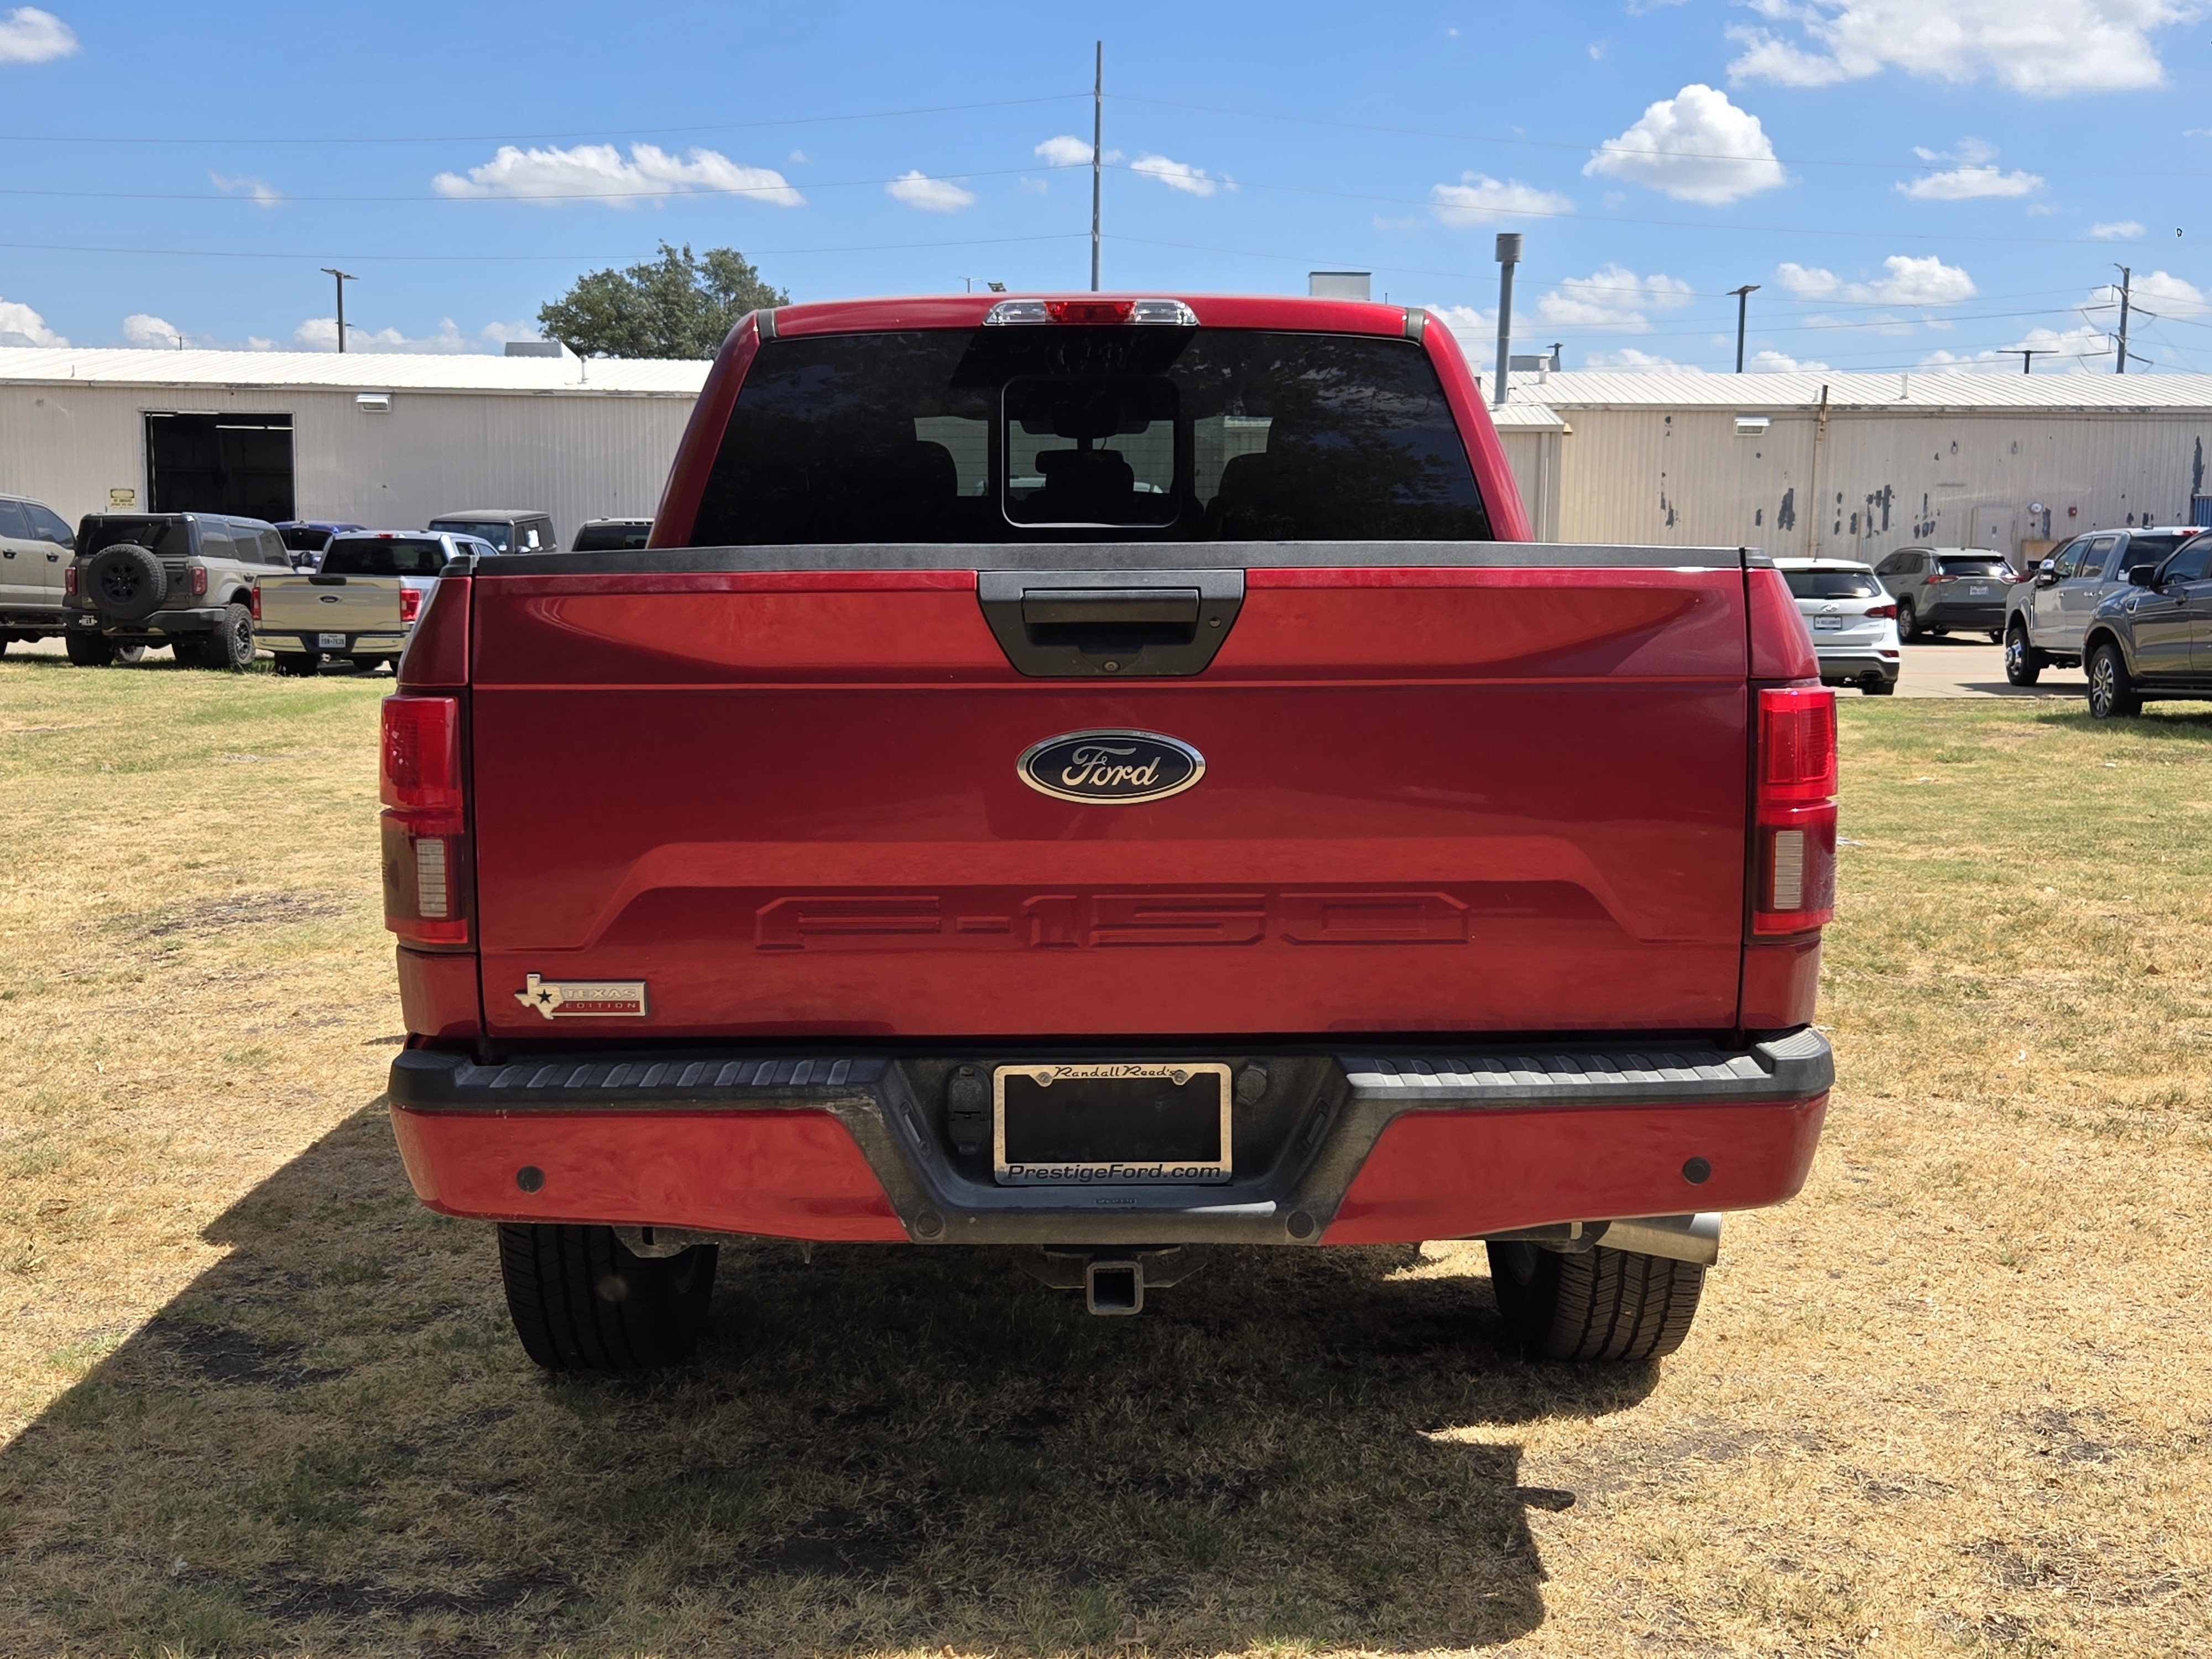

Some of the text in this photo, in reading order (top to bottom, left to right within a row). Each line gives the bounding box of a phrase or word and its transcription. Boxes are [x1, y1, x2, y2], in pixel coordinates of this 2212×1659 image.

[1062, 746, 1161, 786] Ford
[755, 893, 1470, 949] F-150
[564, 989, 637, 999] TEXAS
[1053, 1066, 1176, 1077] Randall Reed's
[1006, 1164, 1220, 1182] PrestigeFord.com
